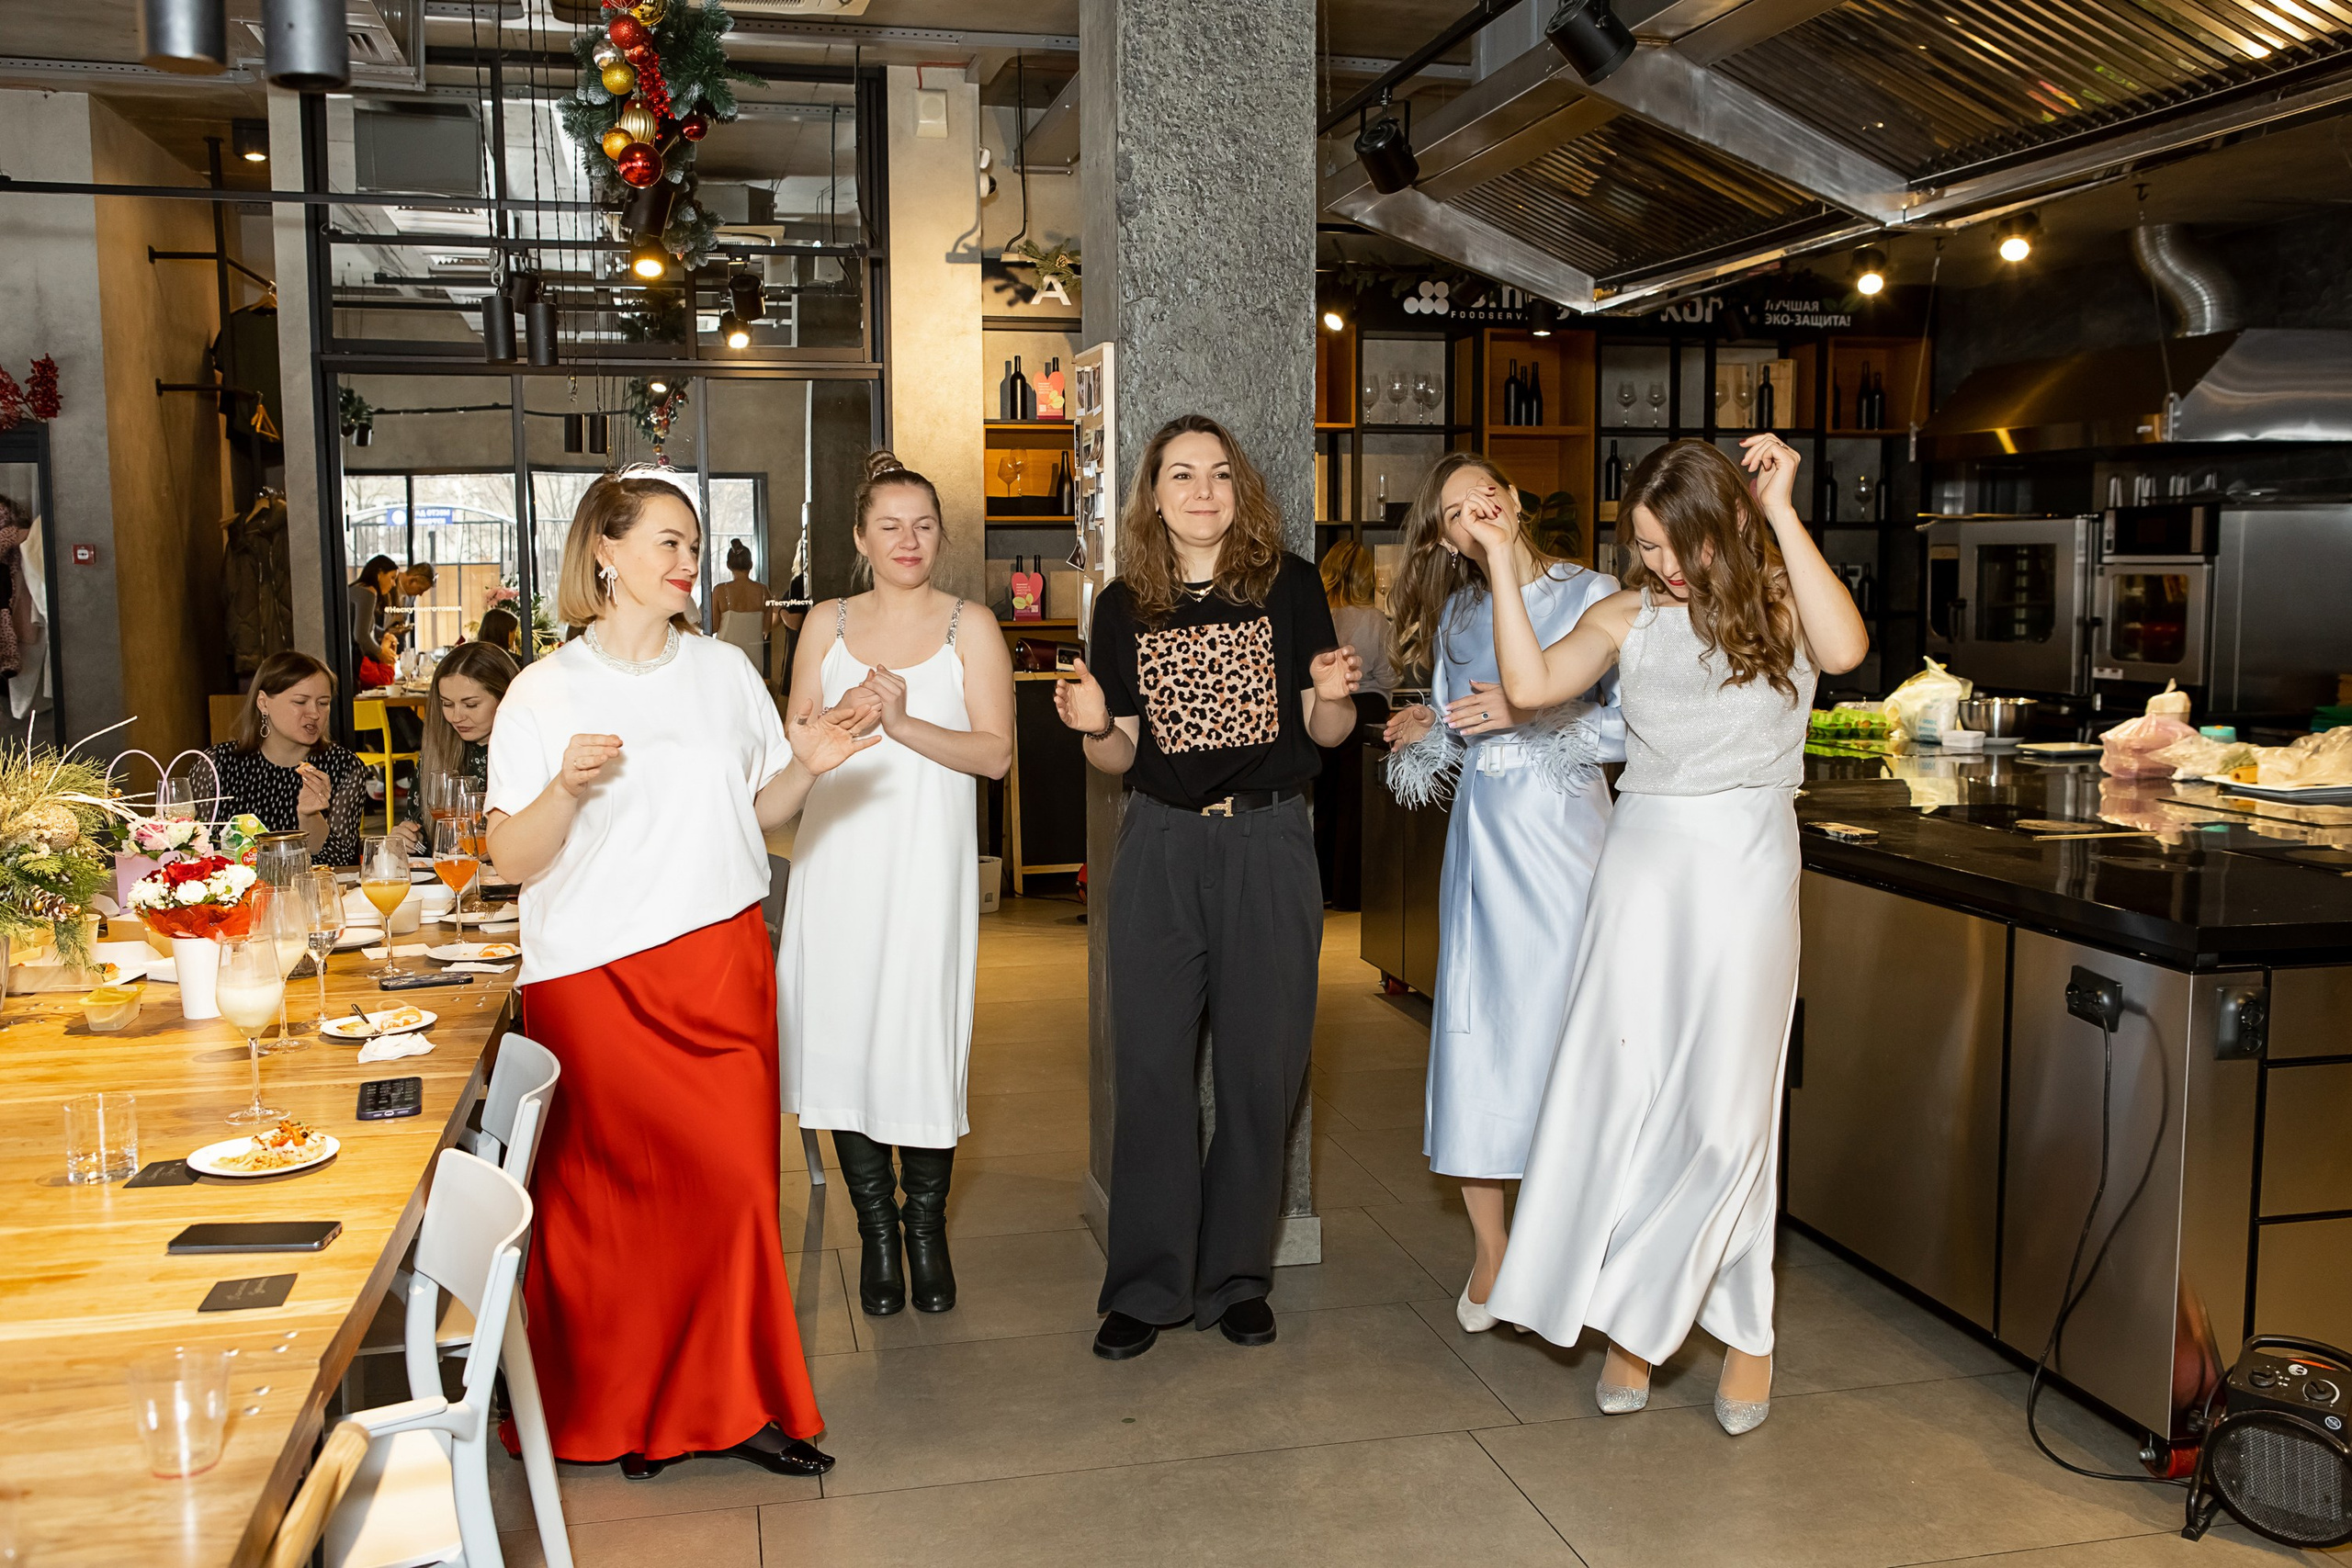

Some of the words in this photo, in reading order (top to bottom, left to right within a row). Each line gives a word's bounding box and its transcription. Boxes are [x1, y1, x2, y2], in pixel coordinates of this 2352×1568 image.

[1764, 299, 1820, 312] ЛУЧШАЯ
[1450, 310, 1529, 321] FOODSERV
[1764, 313, 1851, 329] ЭКО-ЗАЩИТА!
[765, 599, 813, 607] #ТестуМесто
